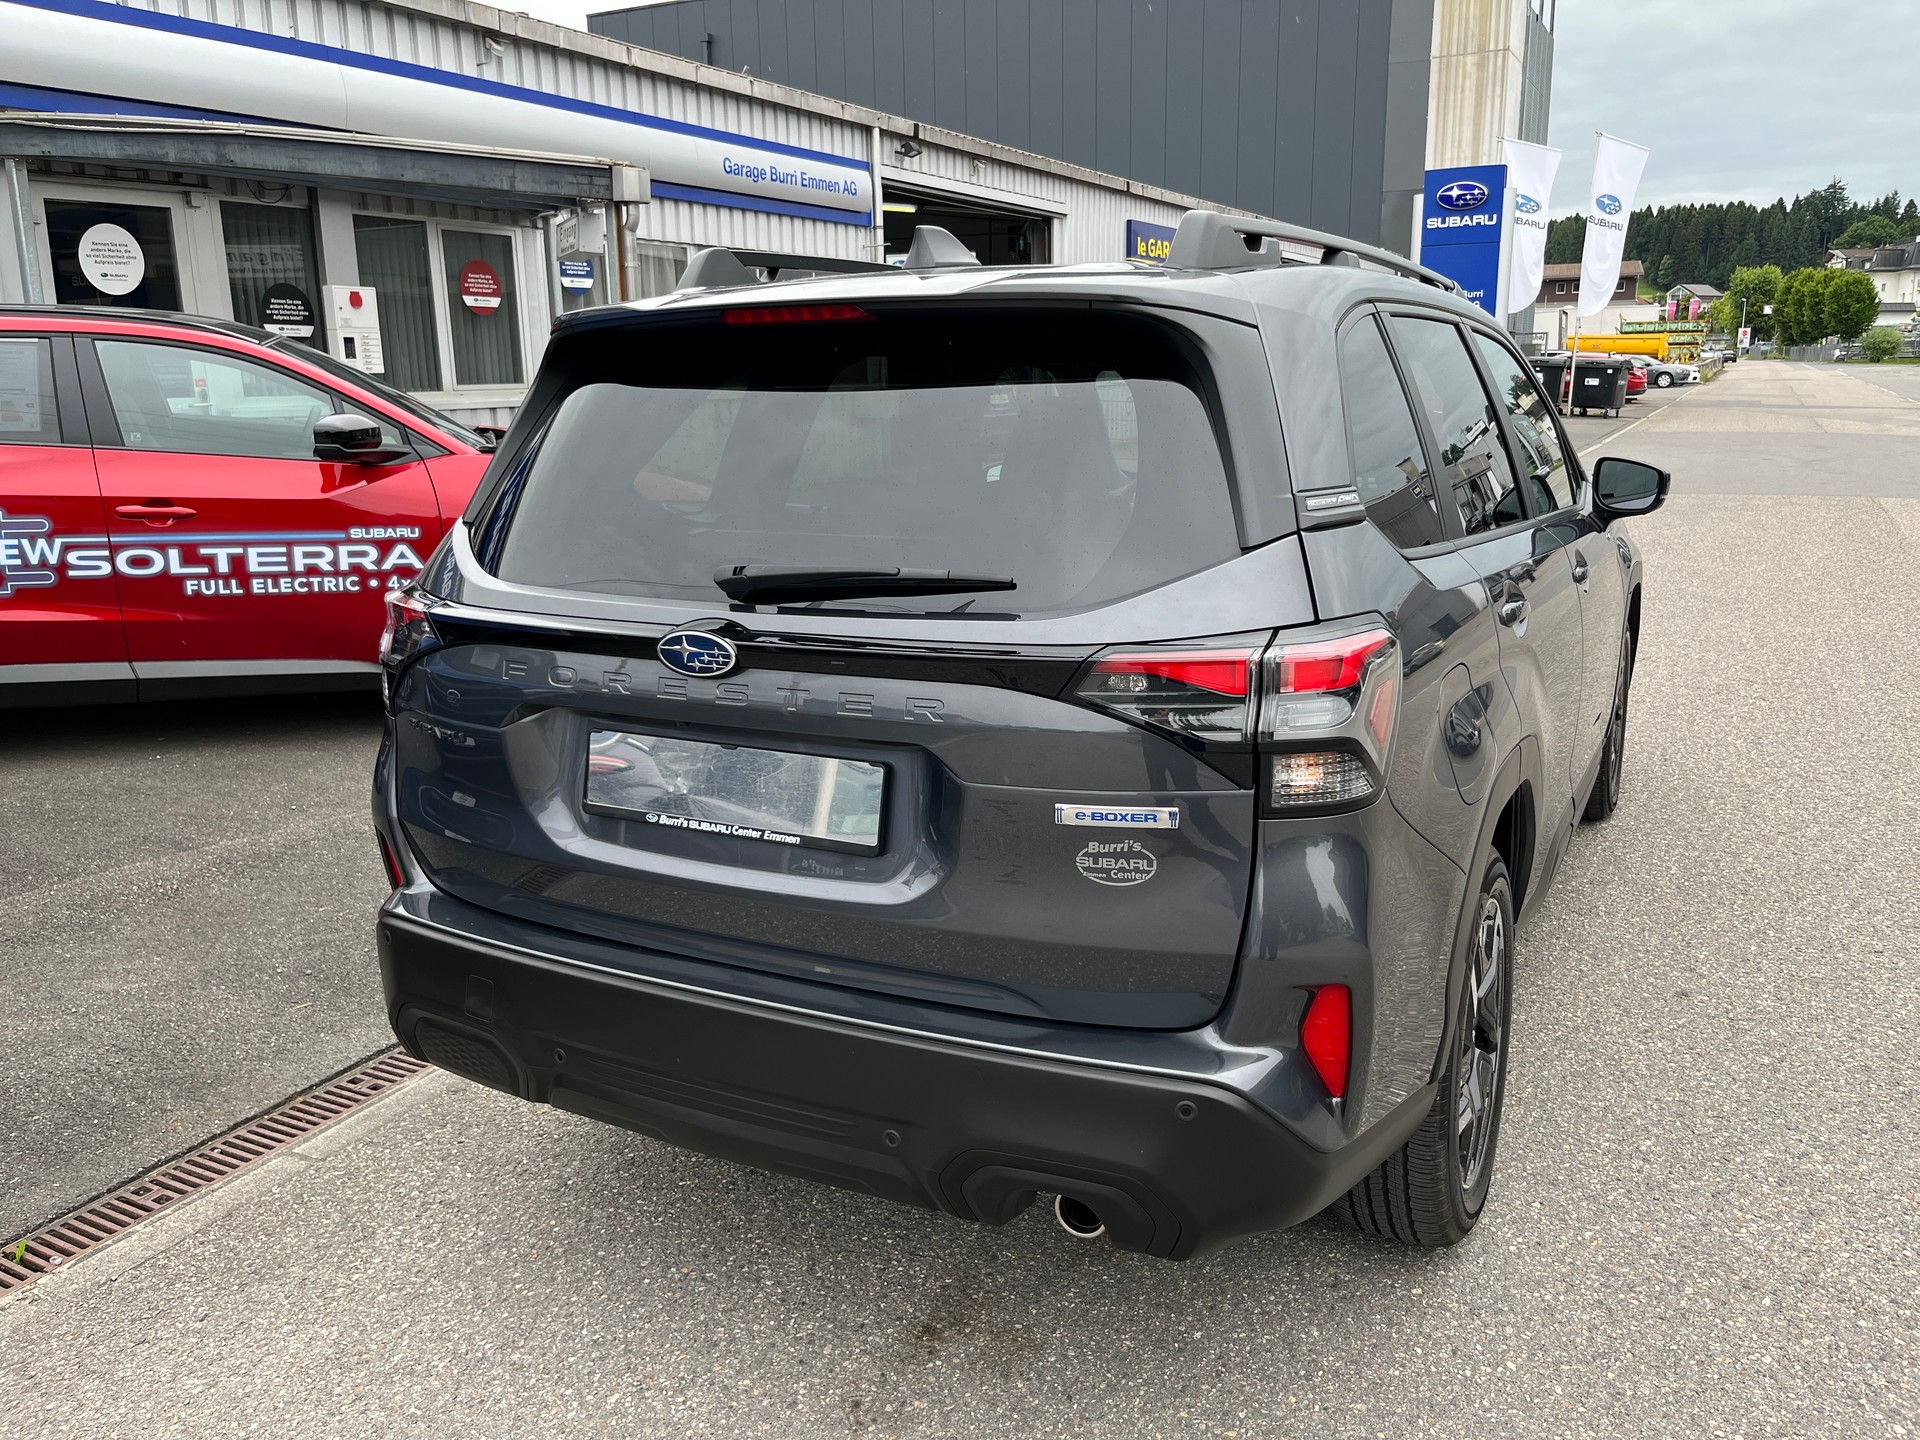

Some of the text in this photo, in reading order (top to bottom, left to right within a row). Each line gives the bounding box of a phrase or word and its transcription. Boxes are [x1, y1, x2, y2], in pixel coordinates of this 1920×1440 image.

[723, 157, 857, 196] Garage Burri Emmen AG
[1426, 214, 1497, 229] SUBARU
[1514, 217, 1546, 230] BARU
[1589, 215, 1624, 231] SUBARU
[1137, 236, 1170, 259] le GAR
[351, 528, 419, 538] SUBARU
[0, 538, 62, 565] EW
[66, 544, 425, 576] SOLTERRA
[186, 576, 411, 595] FULL ELECTRIC 4x
[502, 660, 945, 723] FORESTER
[1075, 811, 1158, 823] e-BOXER
[659, 815, 800, 844] Burri's SUBARU Center Emmen
[1087, 840, 1142, 853] Burri's
[1076, 856, 1157, 870] SUBARU
[1110, 870, 1149, 880] Center
